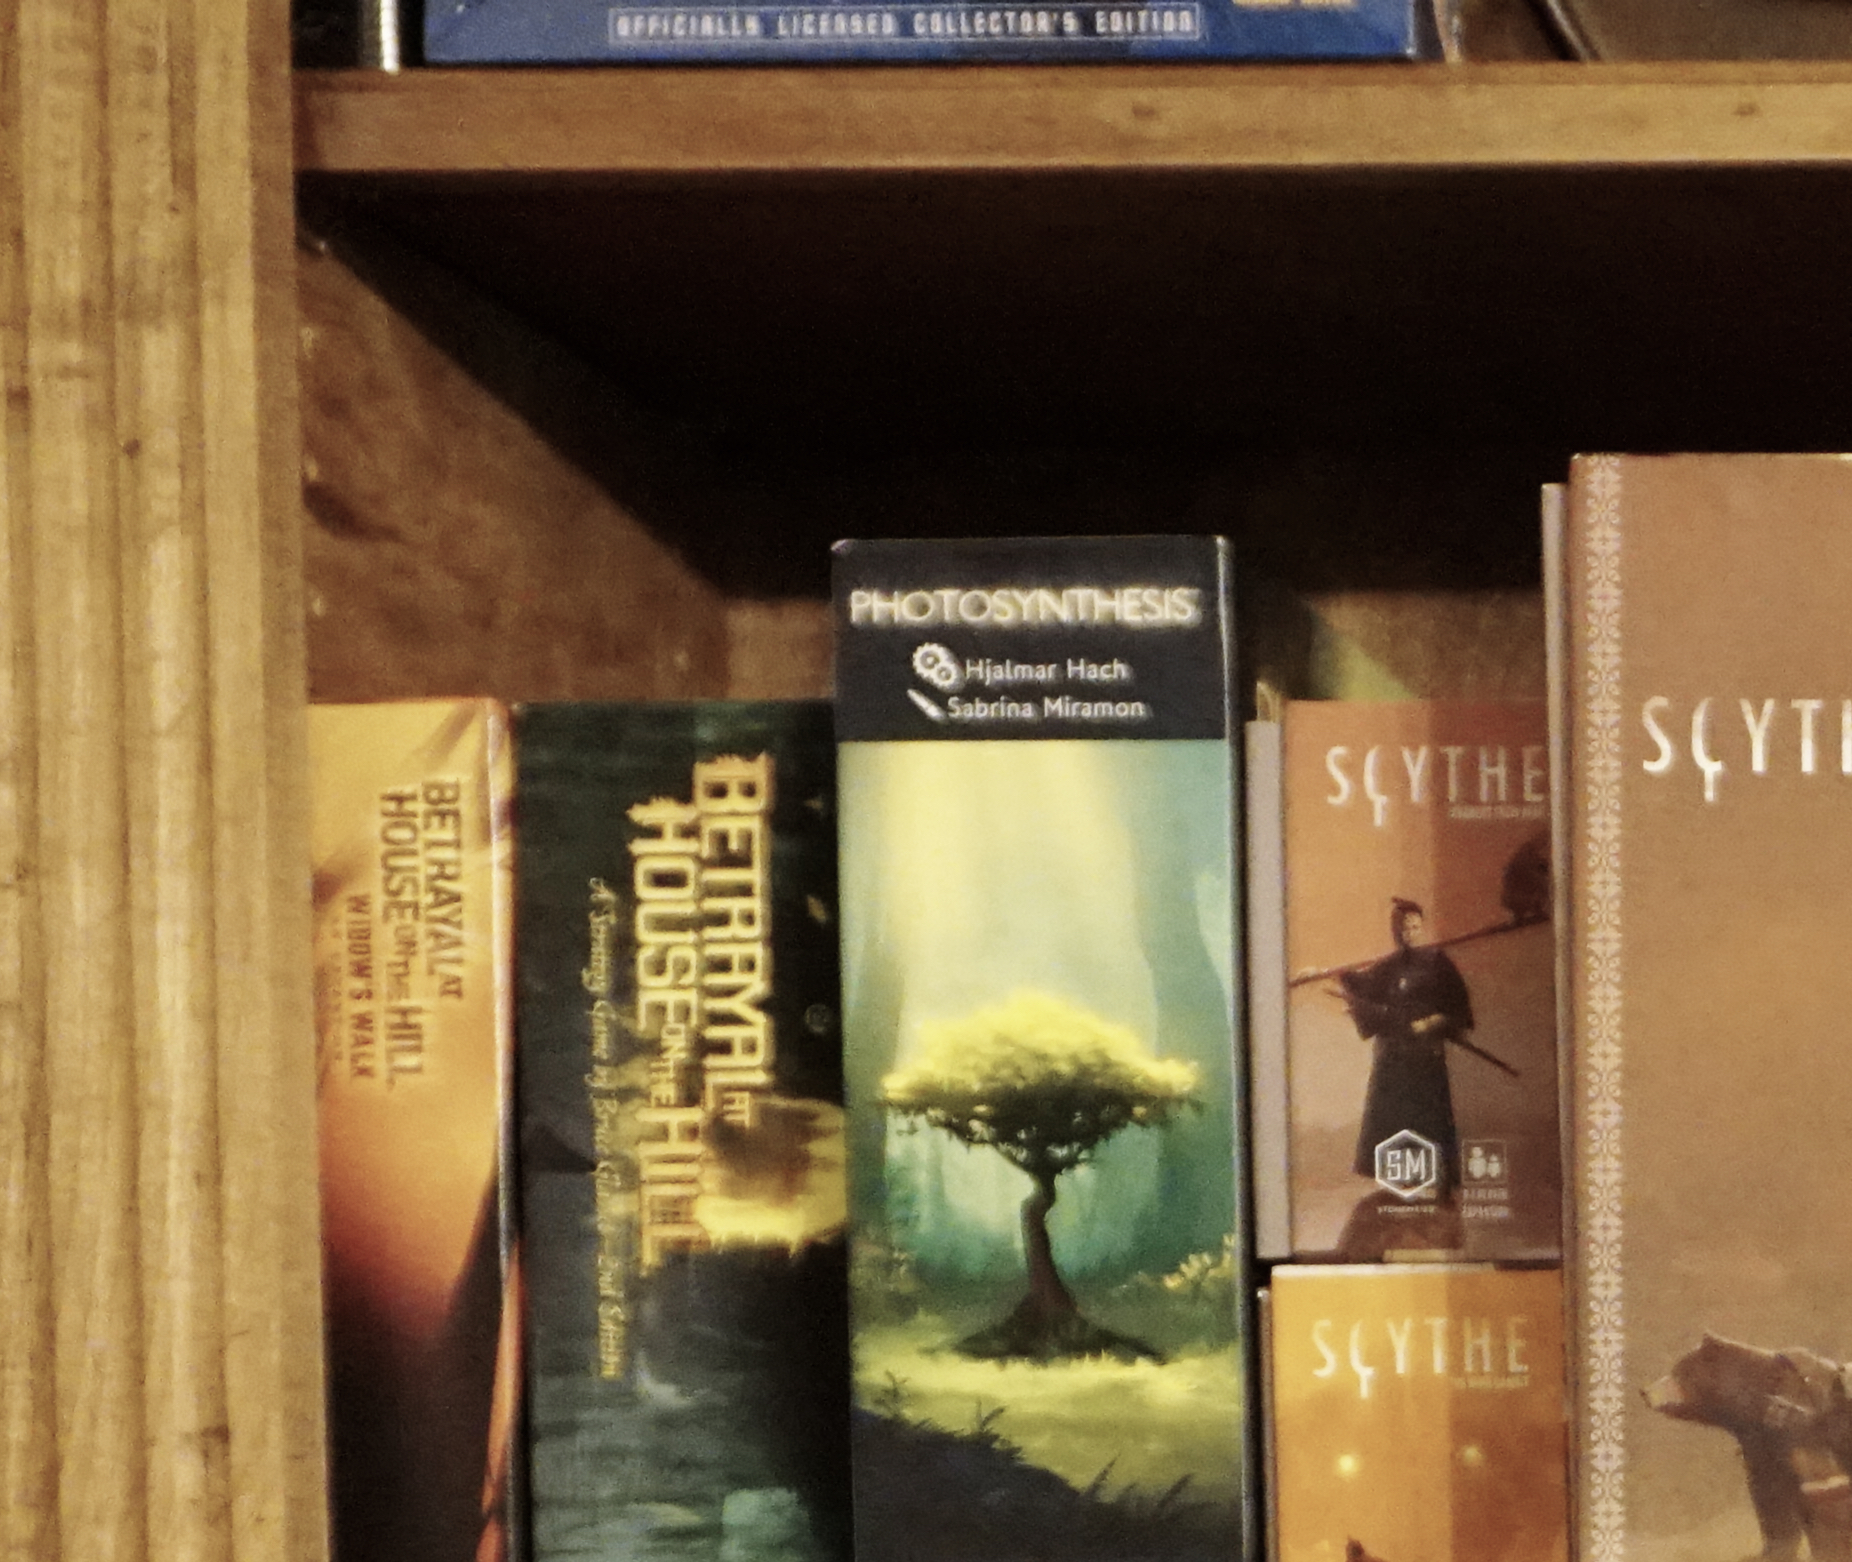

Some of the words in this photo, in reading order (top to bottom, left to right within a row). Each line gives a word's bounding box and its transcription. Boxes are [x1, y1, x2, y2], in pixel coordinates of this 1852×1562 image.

[617, 14, 760, 36] OFFICIALLY
[776, 13, 896, 35] LICENSED
[912, 11, 1077, 34] COLLECTOR'S
[1094, 9, 1193, 33] EDITION
[850, 587, 1200, 627] PHOTOSYNTHESIS
[965, 659, 1058, 683] Hjalmar
[1066, 658, 1127, 682] Hach
[947, 696, 1034, 720] Sabrina
[1044, 696, 1146, 720] Miramon
[1325, 745, 1549, 828] SCYTHE
[380, 788, 422, 925] HOUSE
[422, 778, 463, 976] BETRAYAL
[346, 892, 373, 1000] WIDOW'S
[625, 796, 703, 1036] HOUSE
[695, 750, 776, 1111] BETRAYAL
[437, 974, 463, 1000] AT
[349, 1010, 375, 1080] WALK
[385, 1004, 424, 1086] HILL
[658, 1023, 684, 1059] ON
[649, 1056, 675, 1106] THE
[720, 1090, 751, 1128] AT
[637, 1104, 705, 1278] HILL
[1387, 1149, 1426, 1180] SM
[1311, 1315, 1529, 1399] SCYTHE
